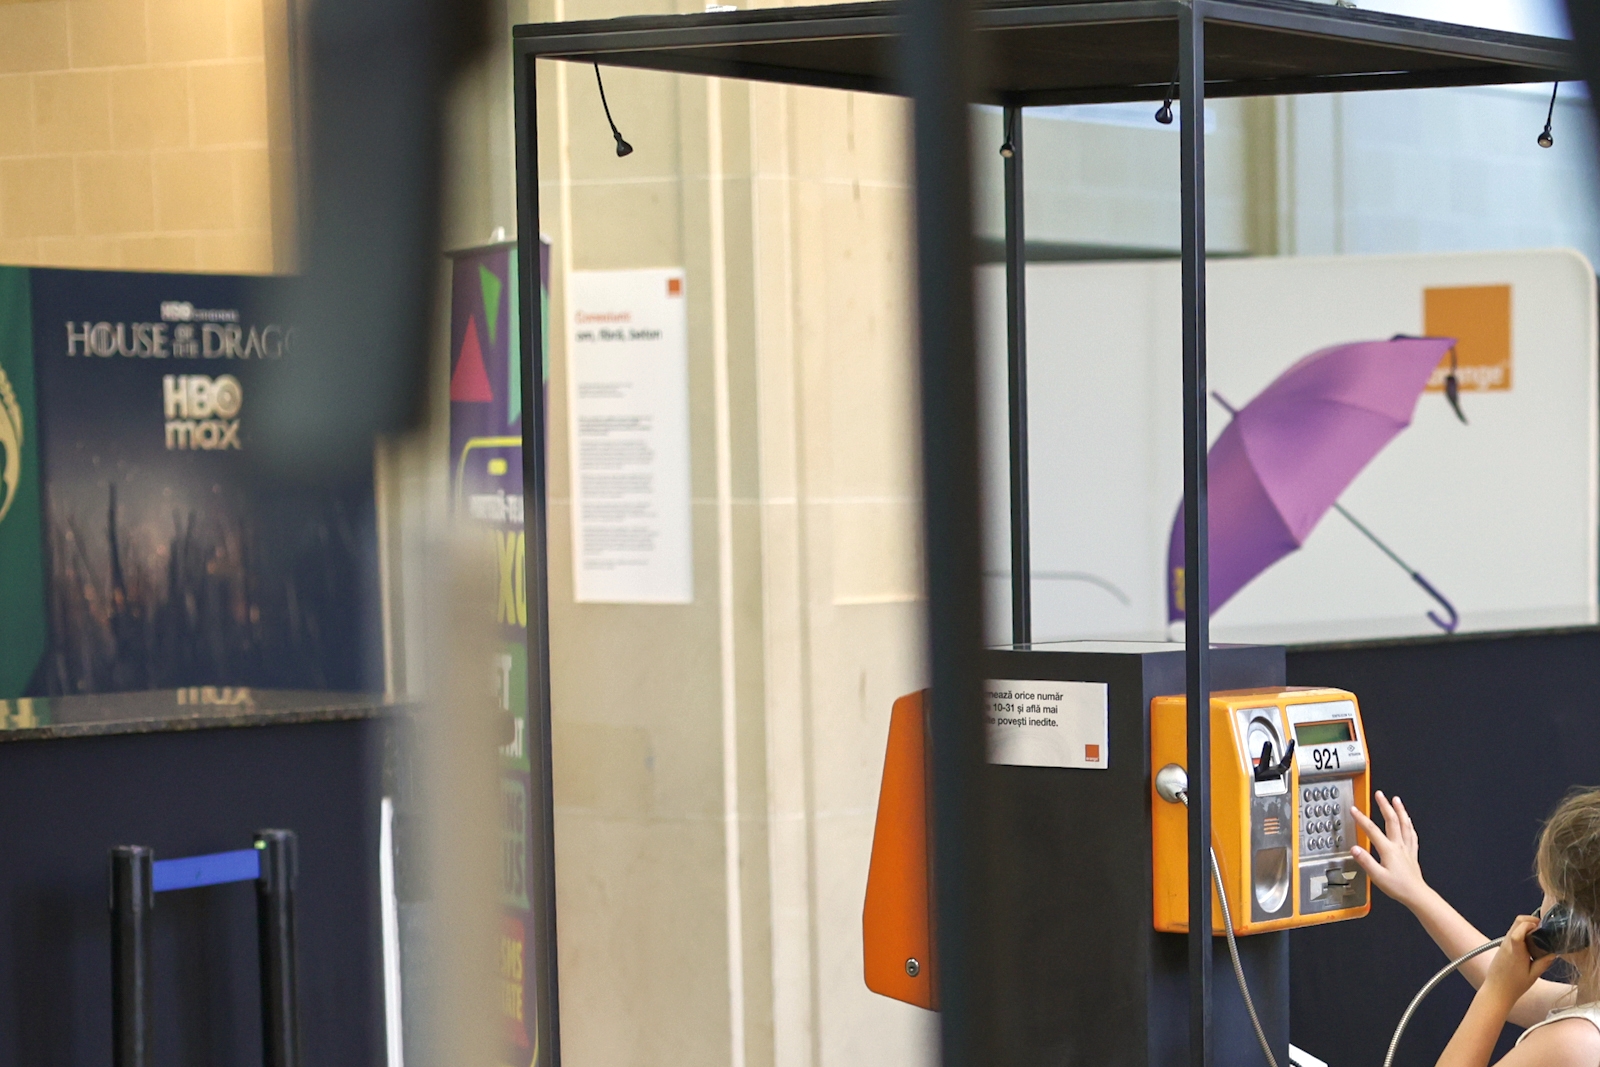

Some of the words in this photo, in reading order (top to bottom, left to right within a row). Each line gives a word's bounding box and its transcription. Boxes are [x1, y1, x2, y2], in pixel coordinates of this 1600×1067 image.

[66, 321, 169, 358] HOUSE
[162, 374, 243, 420] HBO
[164, 419, 242, 450] max
[1014, 691, 1035, 700] orice
[1036, 692, 1064, 701] număr
[992, 703, 1015, 712] 10-31
[1026, 704, 1041, 713] află
[1042, 705, 1058, 714] mai
[1028, 717, 1059, 727] inedite.
[1313, 748, 1341, 770] 921
